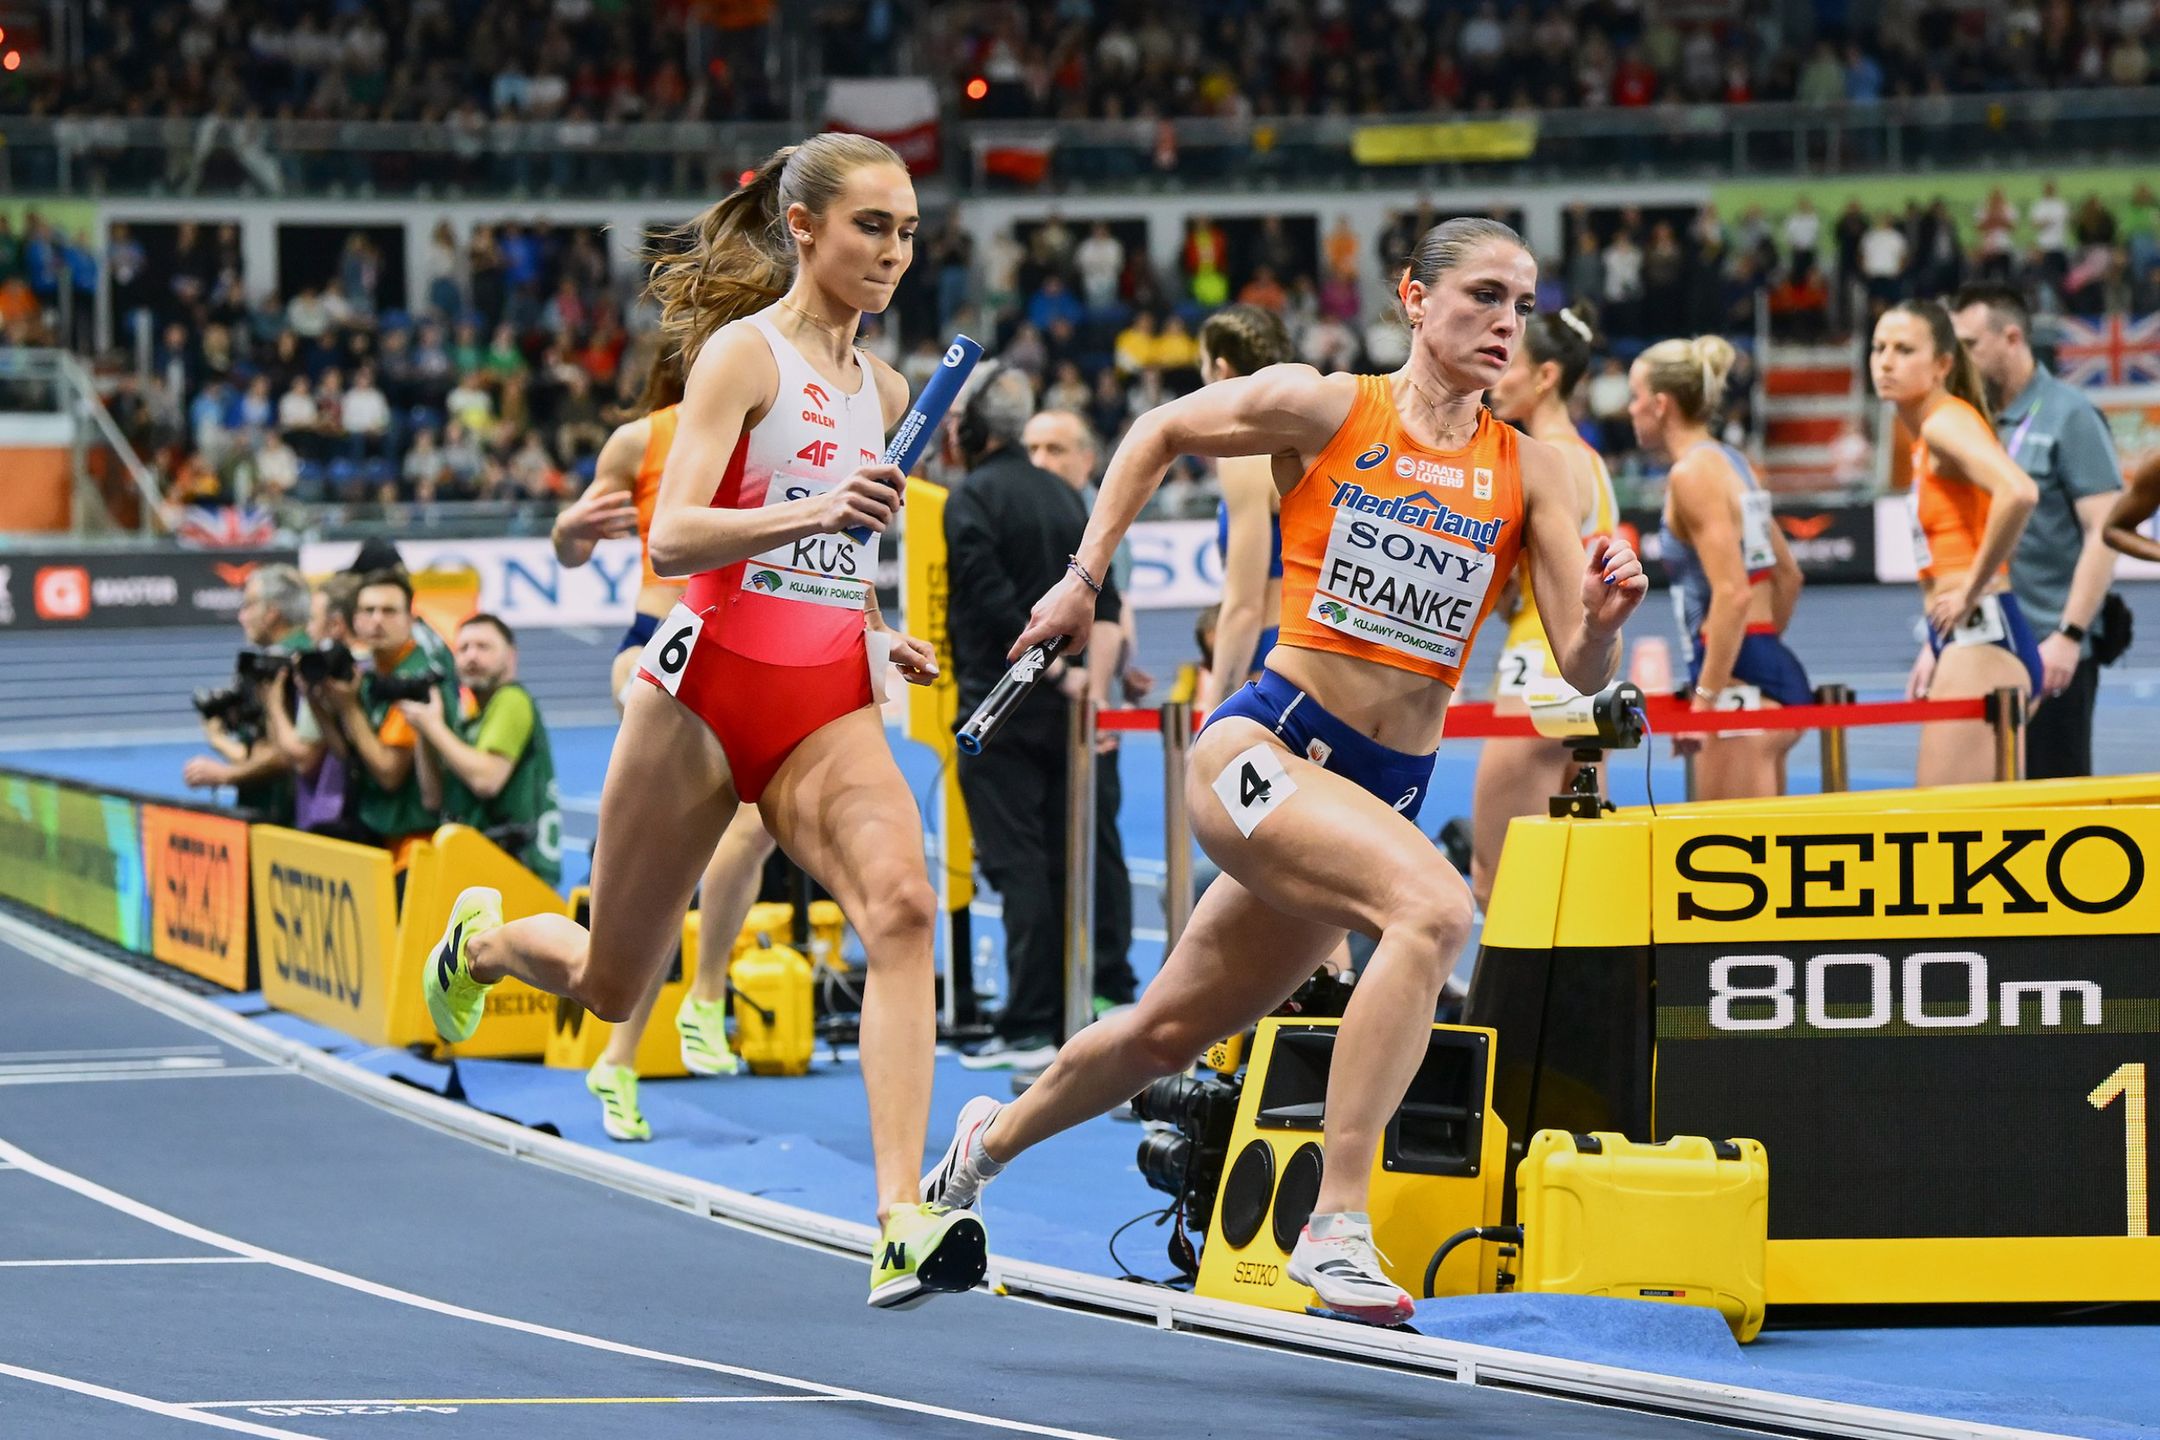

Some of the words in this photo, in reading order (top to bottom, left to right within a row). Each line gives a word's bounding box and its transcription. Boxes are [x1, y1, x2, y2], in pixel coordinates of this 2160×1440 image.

[802, 410, 835, 428] ORLEN
[796, 440, 838, 467] 4F
[1417, 460, 1464, 478] STAATS
[1347, 521, 1484, 583] SONY
[789, 582, 828, 596] KUJAWY
[1328, 558, 1472, 632] FRANKE
[659, 626, 693, 674] 6
[1353, 617, 1394, 637] KUJAWY
[1395, 631, 1443, 655] POMORZE
[1443, 646, 1456, 658] 26
[1513, 657, 1527, 685] 2
[1240, 761, 1272, 808] 4
[1675, 825, 2145, 922] SEIKO
[269, 861, 363, 1008] SEIKO
[483, 991, 556, 1016] EIK
[1708, 951, 2103, 1031] 800m
[2087, 1063, 2148, 1237] 1
[1234, 1261, 1279, 1287] SEIKO
